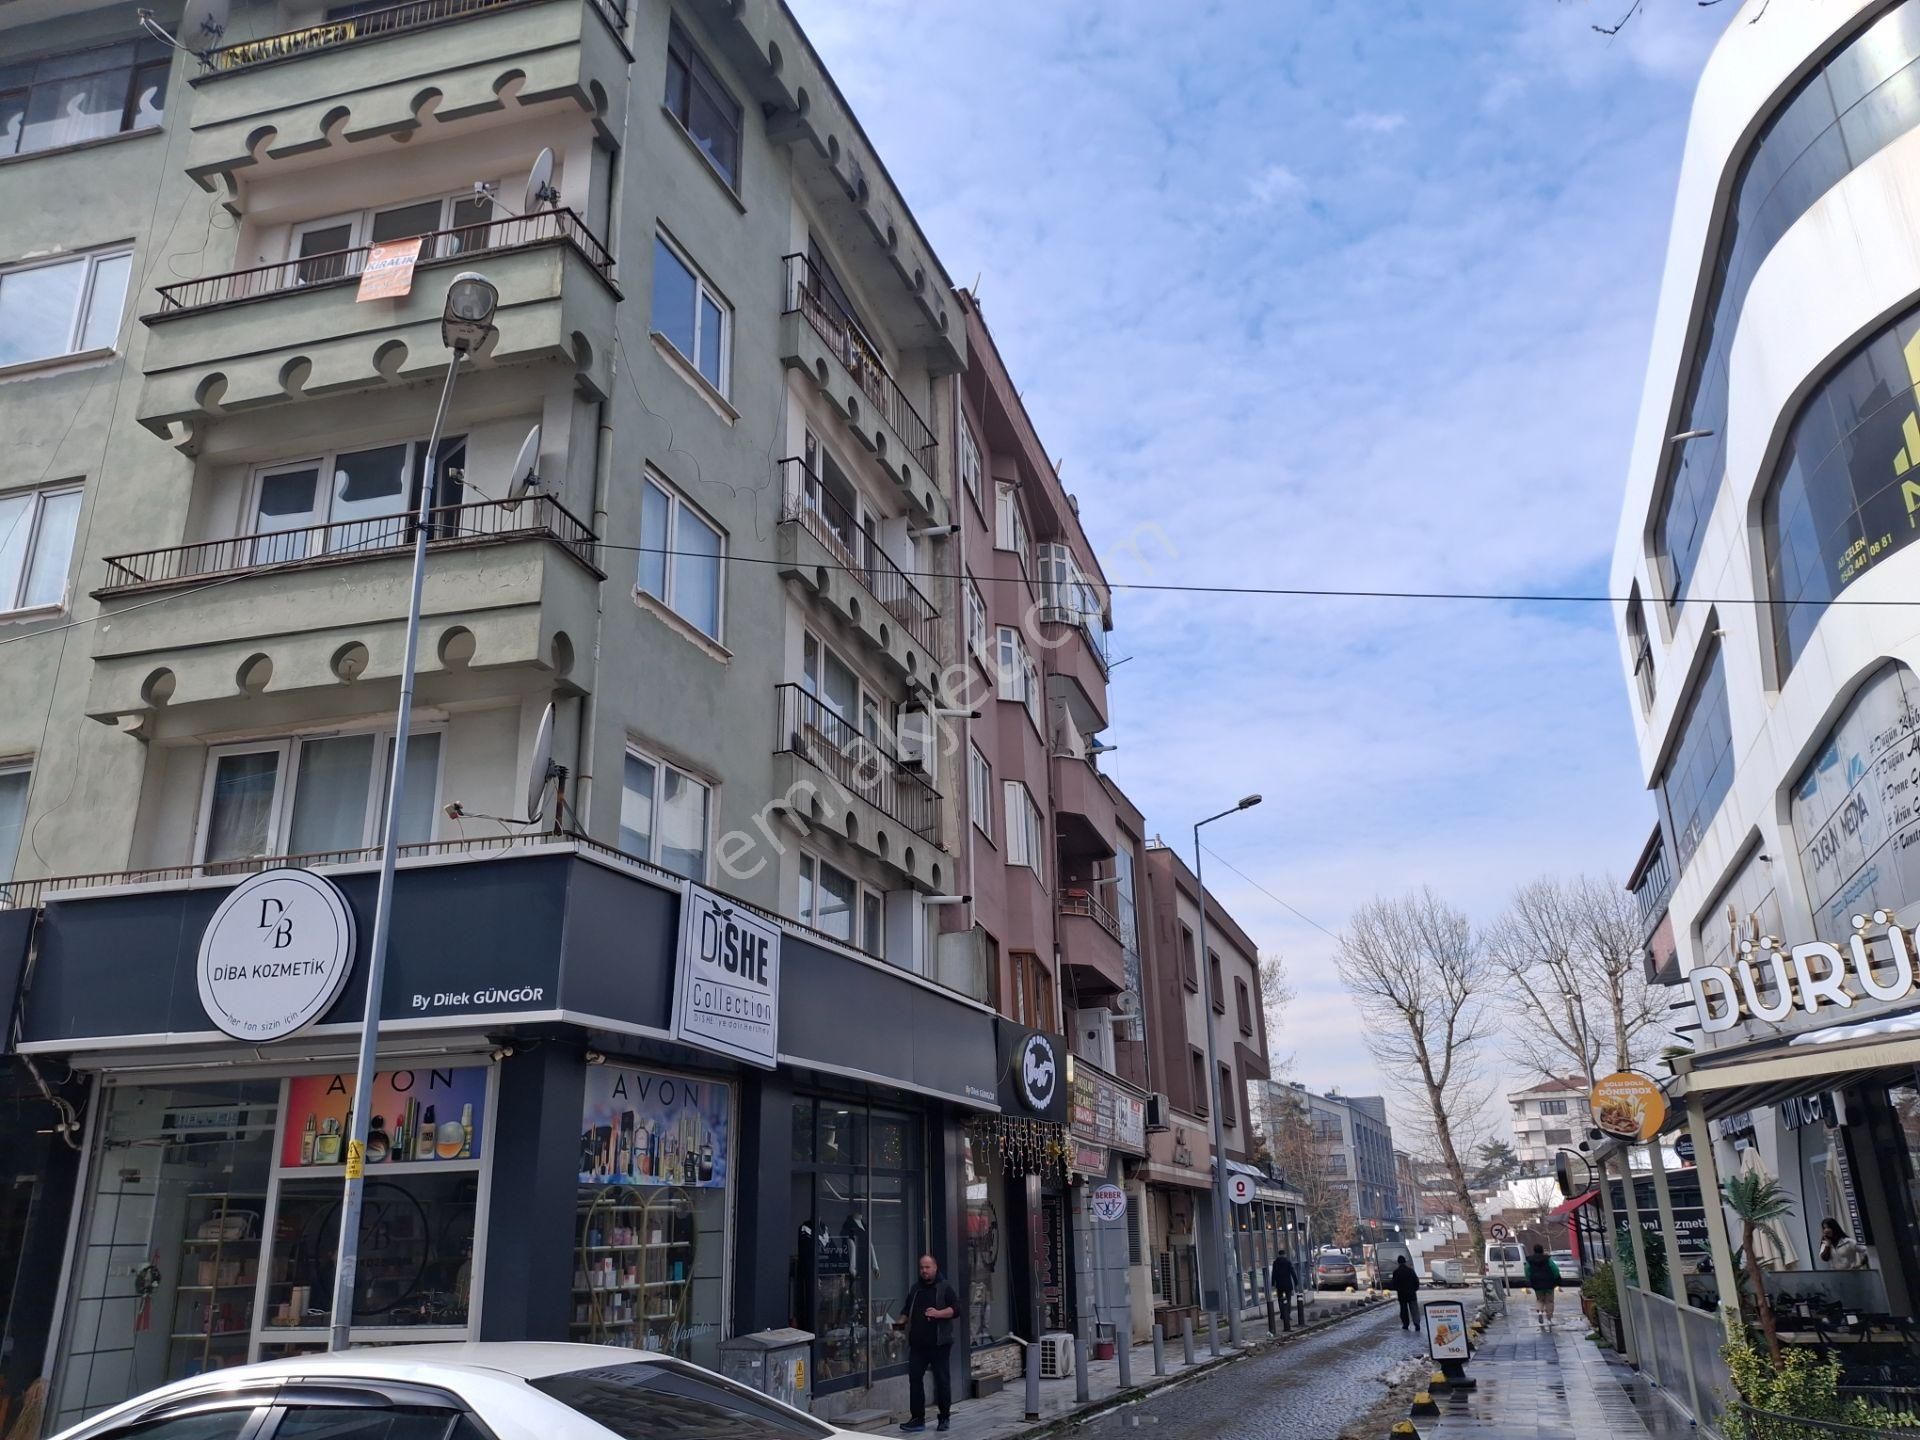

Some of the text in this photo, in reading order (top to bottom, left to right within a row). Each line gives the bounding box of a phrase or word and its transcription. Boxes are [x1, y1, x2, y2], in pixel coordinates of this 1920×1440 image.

[214, 958, 326, 981] DİBA KOZMETİK
[1689, 909, 1920, 1033] DÜRÜ
[412, 985, 543, 1010] By Dilek GÜNGÖR
[693, 983, 771, 1020] Collection
[227, 1013, 241, 1027] her
[261, 1021, 281, 1031] sizin
[284, 1012, 299, 1026] için
[612, 1073, 699, 1108] AVON
[1095, 1191, 1122, 1200] BERBER
